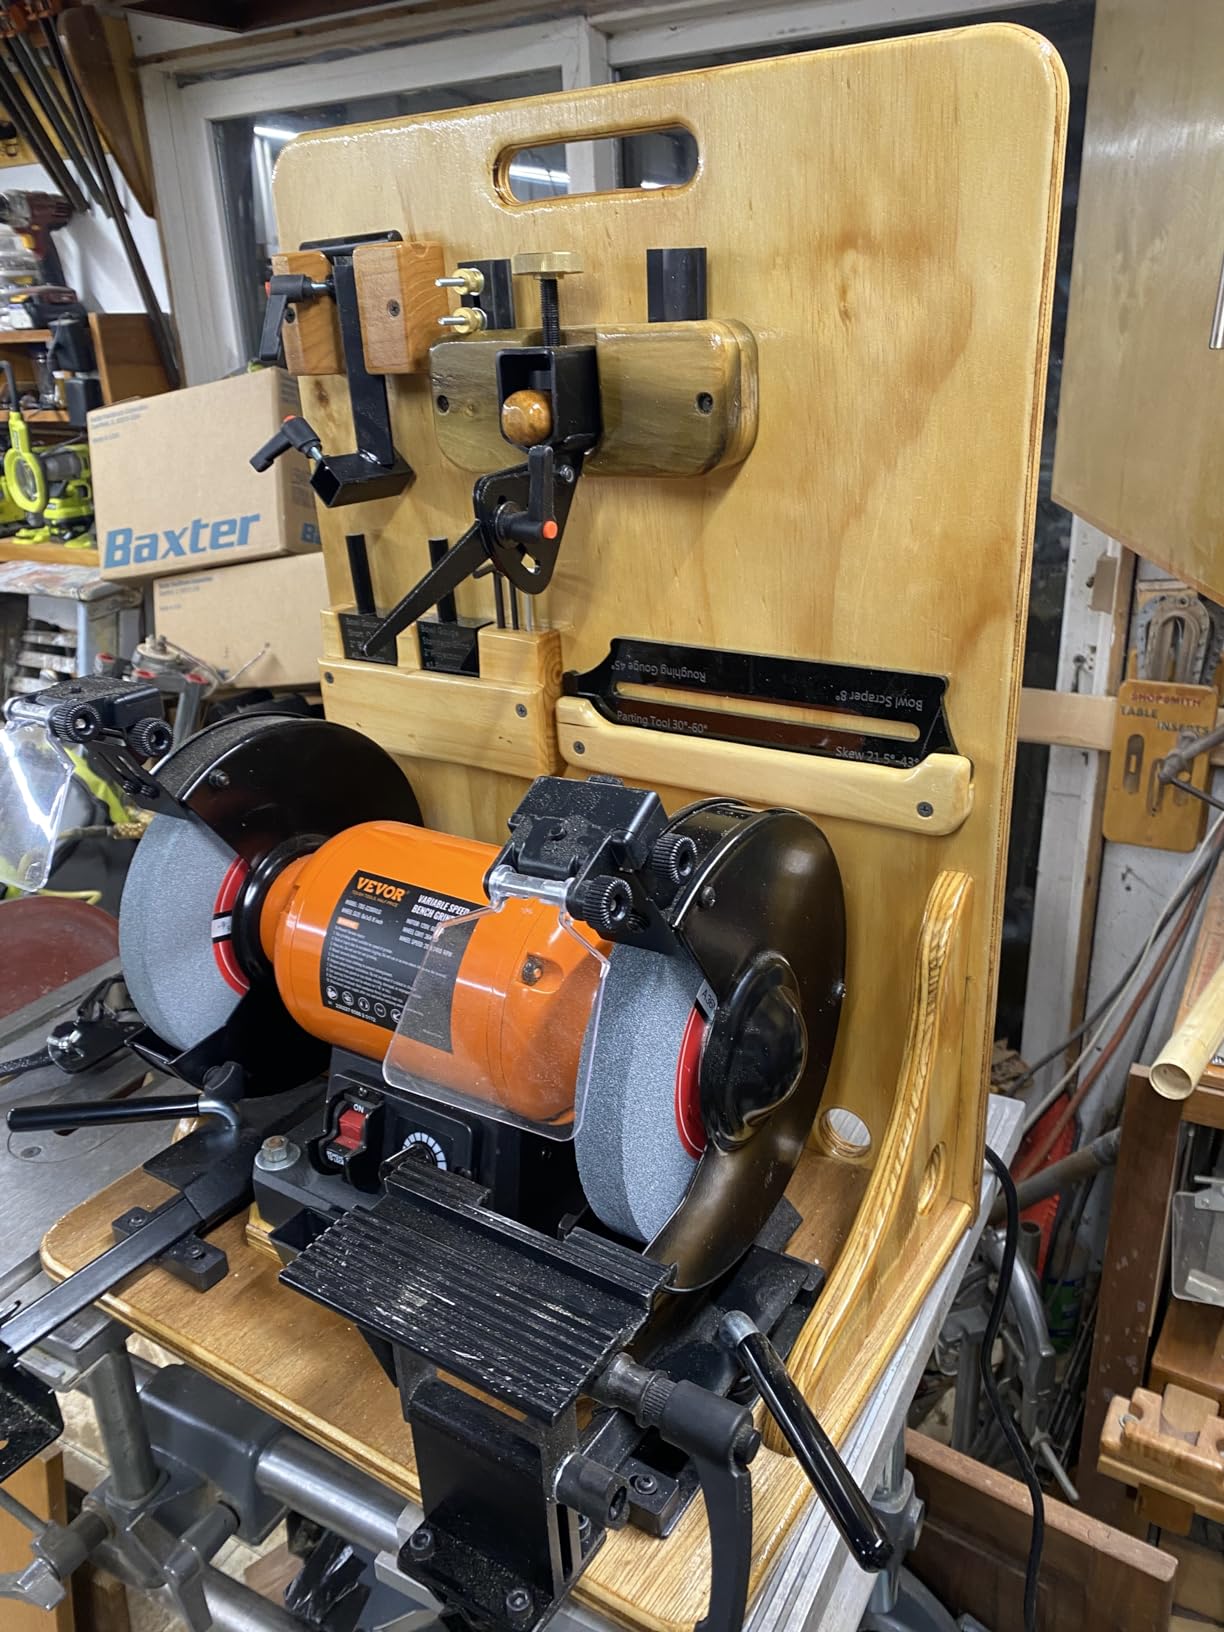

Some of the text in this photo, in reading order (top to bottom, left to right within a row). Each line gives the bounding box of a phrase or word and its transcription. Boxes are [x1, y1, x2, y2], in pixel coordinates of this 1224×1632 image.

[104, 513, 260, 569] Baxter
[611, 659, 706, 683] Roughing Gouge 45°
[835, 689, 923, 711] Bowl Scraper 8°
[616, 710, 708, 734] Parting Tool 30°-60°
[1120, 704, 1158, 719] TABLE
[835, 745, 865, 761] Skew
[356, 876, 406, 902] VEVOR
[410, 903, 434, 918] BENCH
[417, 894, 470, 917] VARIABLE SPEED
[353, 1103, 365, 1113] ON
